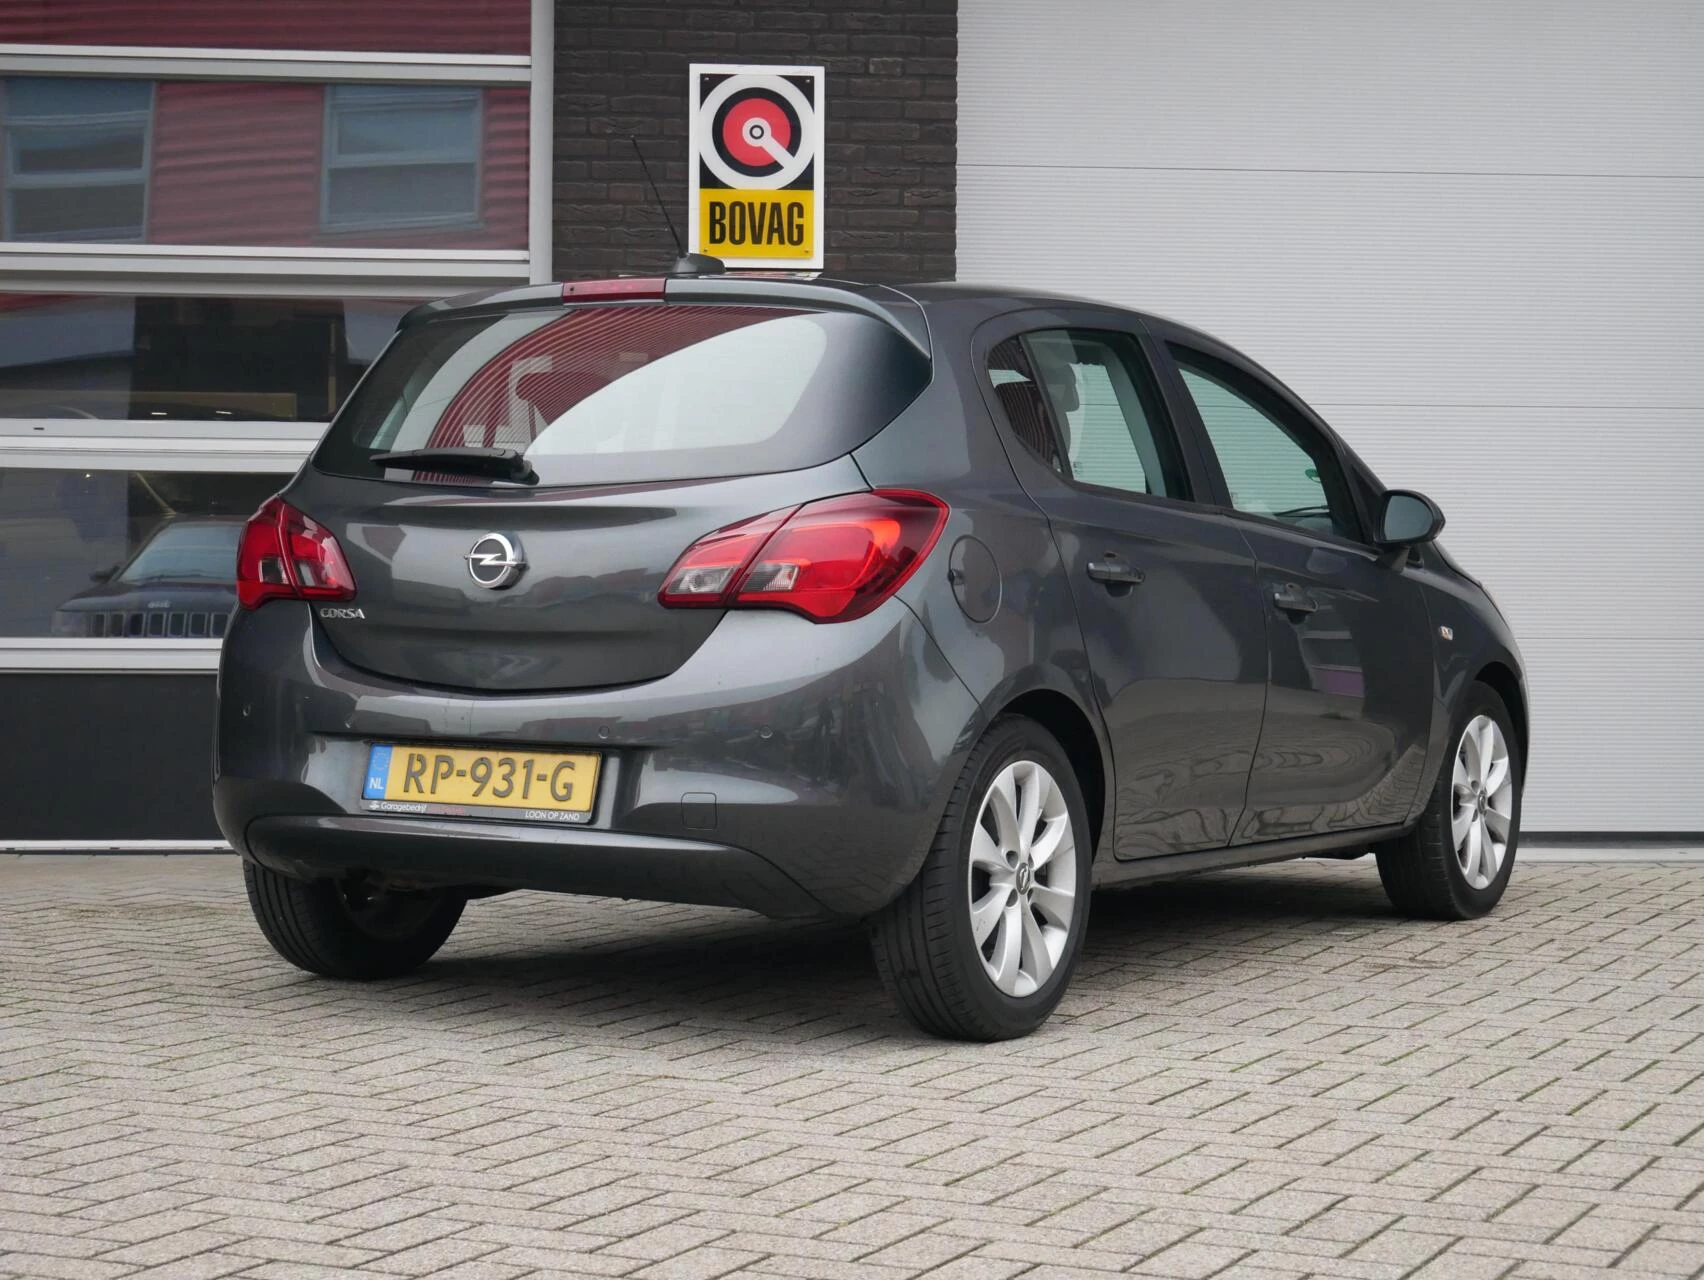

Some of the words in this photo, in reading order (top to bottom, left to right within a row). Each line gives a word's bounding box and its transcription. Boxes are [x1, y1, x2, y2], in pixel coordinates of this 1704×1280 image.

[709, 201, 804, 246] BOVAG
[320, 607, 366, 619] CORSA
[369, 777, 384, 789] NL
[403, 753, 576, 801] RP-931-G
[380, 801, 427, 813] Garagebedrijf
[525, 811, 546, 819] LOON
[547, 812, 559, 820] OP
[559, 813, 580, 821] ZAND
